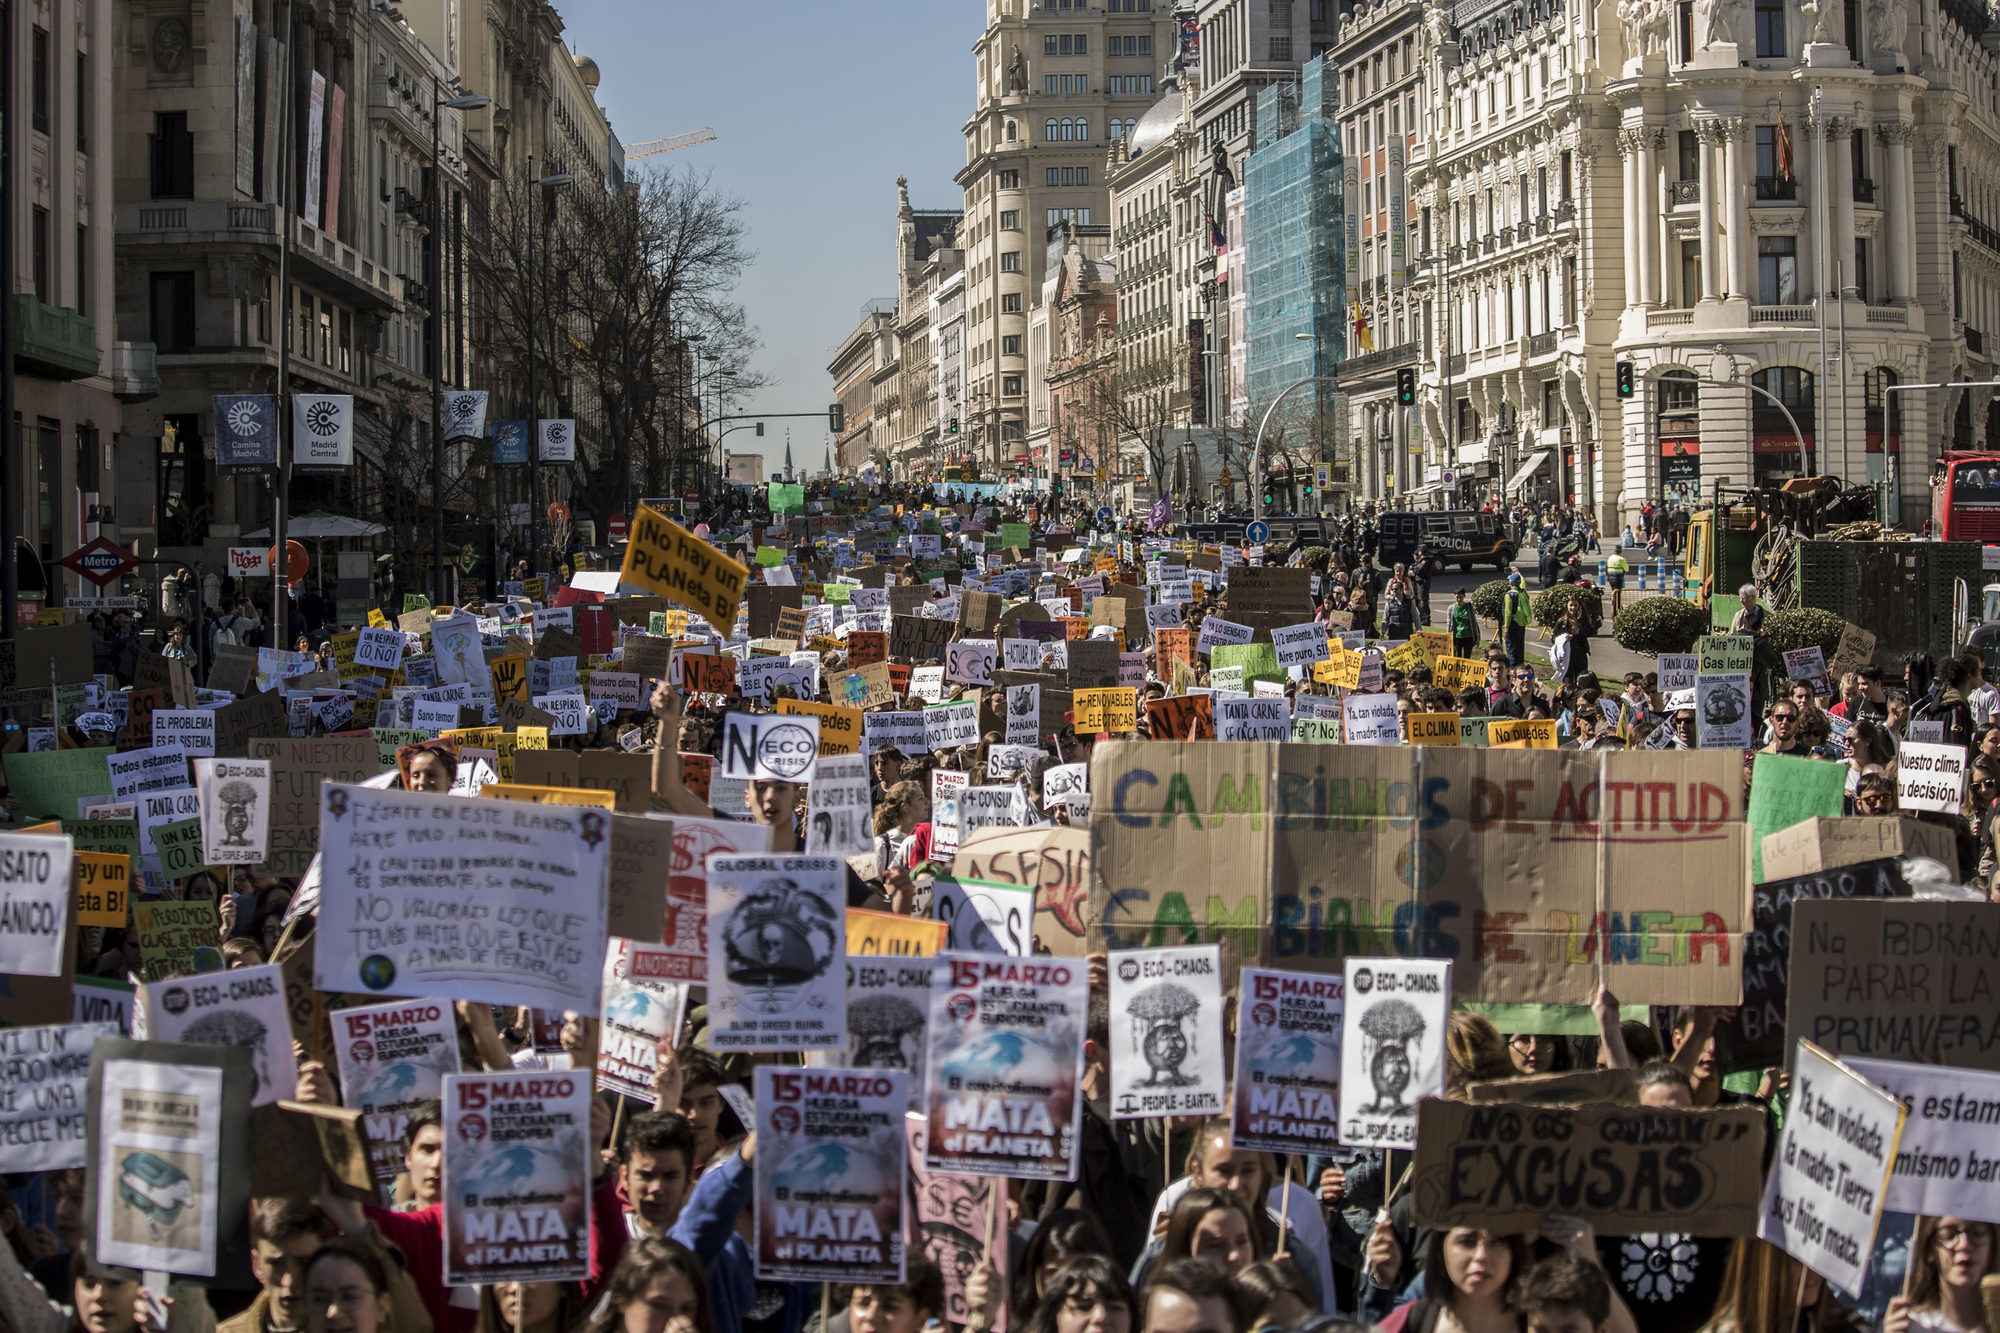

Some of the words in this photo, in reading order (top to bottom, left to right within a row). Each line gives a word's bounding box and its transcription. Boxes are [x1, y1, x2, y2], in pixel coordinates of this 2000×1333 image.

[232, 449, 260, 457] Madrid
[311, 450, 338, 458] Central
[812, 517, 840, 527] GRADO
[1433, 536, 1472, 551] POLICIA
[84, 556, 117, 568] Metro
[638, 519, 672, 551] ¡No
[676, 536, 712, 575] hay
[714, 566, 739, 593] un
[1243, 568, 1260, 577] ONU
[631, 549, 710, 606] PLANeta
[714, 595, 735, 622] B!
[68, 599, 92, 607] Banco
[108, 598, 135, 607] España
[1238, 602, 1260, 610] CRISIS
[538, 614, 545, 622] No
[547, 612, 568, 621] queméis
[780, 612, 805, 624] CLIMATE
[779, 621, 803, 632] CHANGE
[1208, 621, 1218, 633] YA
[1218, 623, 1225, 635] LO
[1226, 624, 1248, 640] SENSATO
[364, 632, 373, 642] UN
[1275, 634, 1287, 647] 1/2
[1289, 628, 1314, 645] ambiente,
[1315, 623, 1325, 639] NO!
[1739, 639, 1754, 651] No:
[1279, 650, 1293, 663] Aire
[1787, 653, 1795, 661] 15
[1795, 648, 1817, 659] MARZO
[1663, 658, 1681, 671] TANTA
[1726, 656, 1752, 670] letal!
[340, 669, 352, 679] NOS
[590, 677, 616, 688] Nuestro
[618, 678, 638, 690] clima,
[444, 686, 465, 700] CARNE
[601, 692, 638, 704] decisión.
[1087, 693, 1133, 708] RENOVABLES
[539, 701, 548, 711] UN
[1224, 703, 1249, 721] TANTA
[1252, 703, 1282, 720] CARNE
[1347, 704, 1357, 720] Ya,
[1358, 706, 1369, 718] tan
[156, 718, 165, 729] EL
[168, 717, 213, 730] PROBLEMA
[417, 710, 434, 721] Sano
[436, 711, 455, 723] temor
[867, 716, 889, 728] Dañan
[890, 714, 924, 728] Amazonia
[925, 712, 951, 725] CAMBIA
[1088, 712, 1135, 727] ELÉCTRICAS.
[1008, 720, 1038, 731] MAÑANA
[1356, 729, 1377, 740] madre
[1378, 725, 1398, 739] Tierra
[1413, 722, 1424, 737] EL
[1427, 721, 1456, 737] CLIMA
[929, 731, 941, 743] NO
[942, 729, 952, 740] TU
[953, 725, 977, 738] CLIMA
[180, 736, 213, 748] SISTEMA.
[526, 736, 545, 749] CAMBIO
[765, 741, 812, 754] ECO
[869, 736, 893, 748] pulmón
[256, 742, 280, 758] CON
[291, 743, 365, 764] NUESTRO
[111, 763, 140, 776] Todos
[142, 752, 183, 767] estamos
[766, 756, 806, 766] CRISIS
[1899, 752, 1932, 770] Nuestro
[1934, 753, 1962, 777] clima,
[117, 787, 127, 797] en
[129, 783, 136, 794] el
[138, 777, 162, 791] mismo
[164, 775, 188, 787] barco.
[936, 774, 943, 785] 15
[944, 774, 965, 784] MARZO
[1907, 780, 1959, 803] decisión.
[1113, 768, 1450, 834] CAMBIAMOS
[1470, 777, 1535, 834] DE
[1550, 781, 1729, 834] ACTITUD
[714, 860, 778, 872] GLOBAL
[783, 860, 838, 872] CRISIS
[355, 898, 393, 922] NO
[1546, 910, 1731, 967] PLANETA
[950, 962, 979, 989] 15
[983, 964, 1072, 987] MARZO
[1119, 963, 1138, 976] STOP
[1253, 976, 1277, 1000] 15
[1822, 964, 1930, 1001] PARAR
[1949, 964, 1990, 1004] LA
[372, 1006, 441, 1029] MARZO
[715, 1034, 756, 1045] PEOPLES
[760, 1034, 778, 1045] AND
[781, 1034, 799, 1045] THE
[803, 1034, 839, 1045] PLANET
[457, 1083, 487, 1110] 15
[490, 1079, 575, 1099] MARZO
[771, 1075, 801, 1103] 15
[805, 1076, 894, 1097] MARZO
[490, 1103, 544, 1114] HUELGA
[1250, 1089, 1337, 1122] MATA
[490, 1114, 576, 1129] ESTUDIANTIL
[943, 1099, 1056, 1136] MATA
[1798, 1076, 1813, 1117] Ya,
[1836, 1107, 1884, 1168] violada,
[490, 1129, 554, 1142] EUROPEA
[1268, 1121, 1338, 1140] PLANETA
[965, 1135, 1055, 1158] PLANETA
[1894, 1150, 1959, 1178] mismo
[1449, 1144, 1703, 1213] EXCUSAS
[774, 1188, 788, 1201] El
[794, 1189, 880, 1204] capitalismo
[1836, 1161, 1875, 1216] Tierra
[483, 1192, 566, 1207] capitalismo
[465, 1209, 570, 1244] MATA
[772, 1207, 884, 1243] MATA
[465, 1250, 483, 1266] el
[486, 1244, 569, 1264] PLANETA
[774, 1247, 792, 1260] el
[795, 1243, 882, 1264] PLANETA
